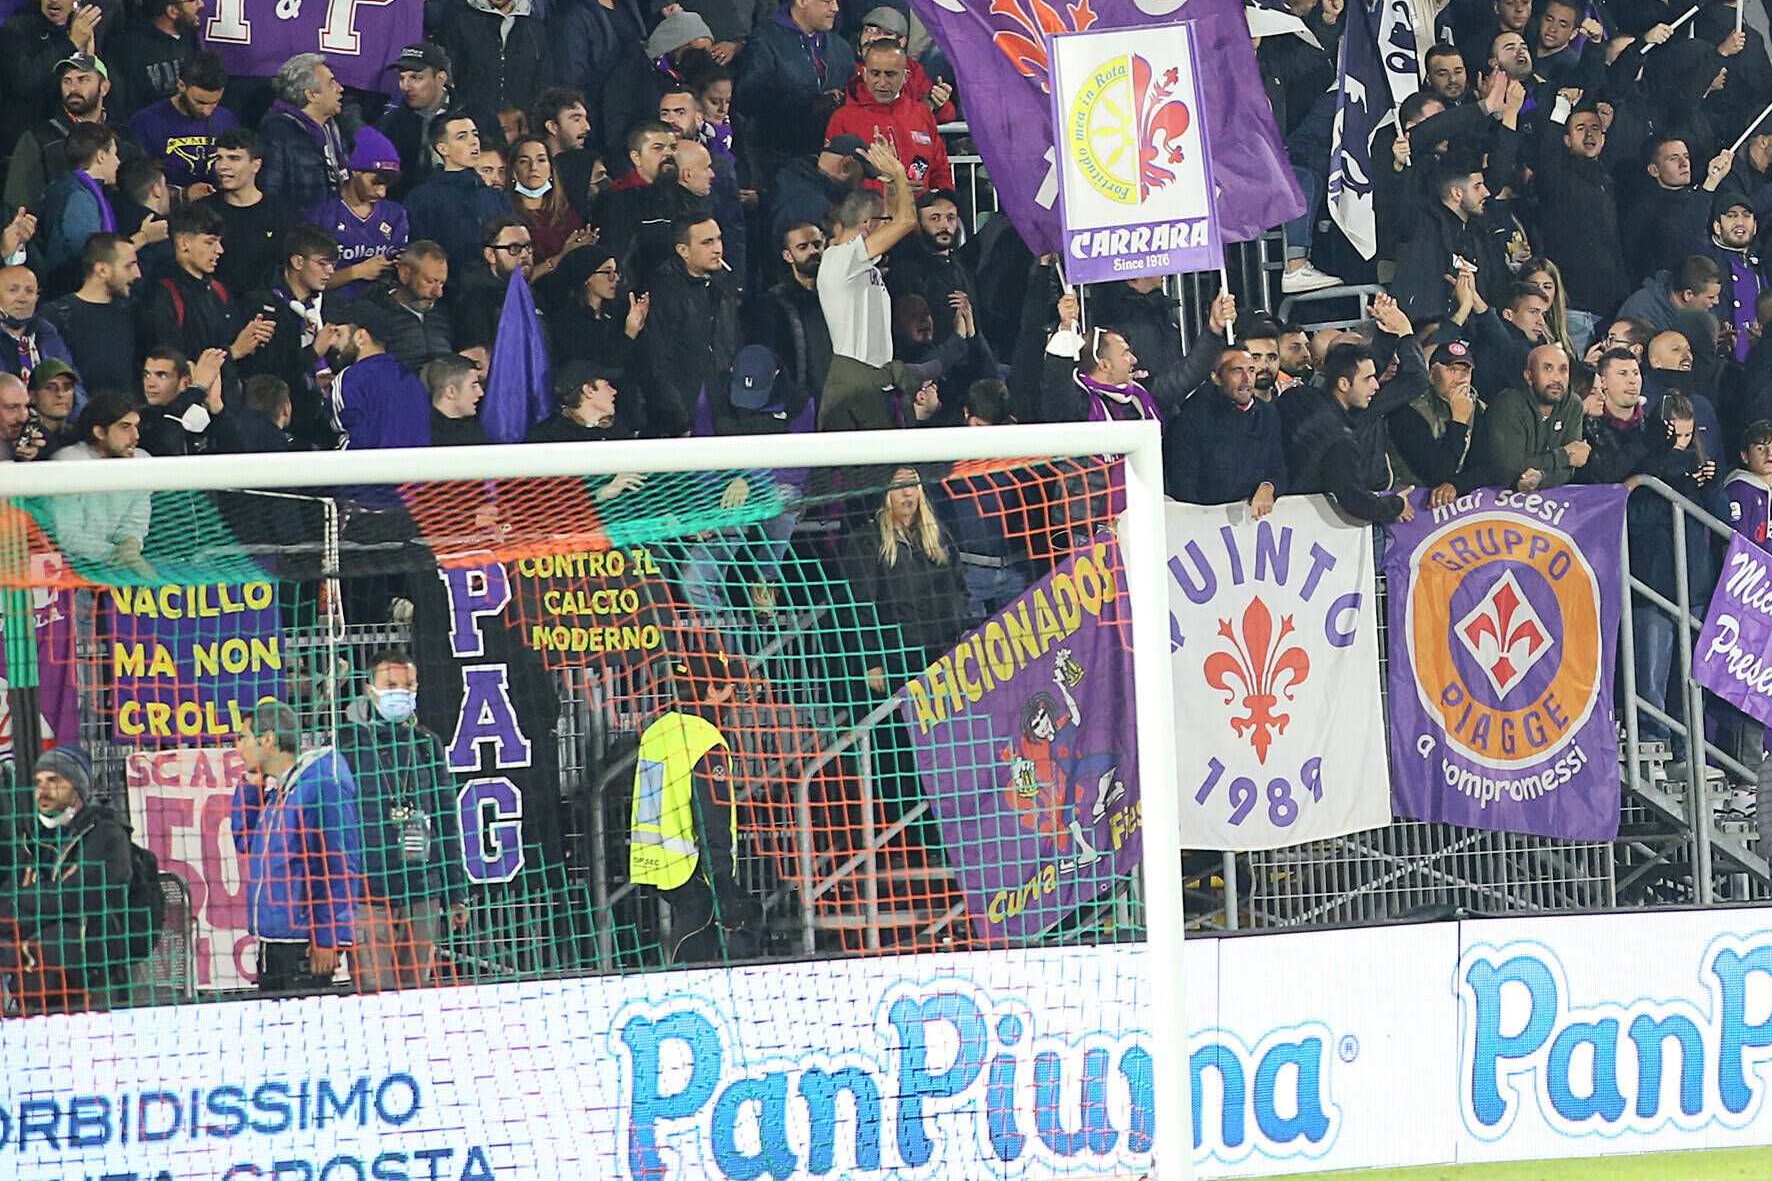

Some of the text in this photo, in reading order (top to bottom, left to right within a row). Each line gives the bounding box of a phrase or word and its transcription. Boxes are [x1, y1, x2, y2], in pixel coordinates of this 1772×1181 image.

[1070, 219, 1210, 260] CARRARA
[1113, 257, 1145, 273] Since
[1494, 489, 1570, 526] scesi
[517, 551, 625, 579] CONTRO
[1431, 527, 1573, 582] GRUPPO
[543, 587, 640, 616] CALCIO
[114, 636, 283, 677] MA NON
[532, 624, 661, 652] MODERNO
[906, 542, 1116, 736] AFICIONADOS
[118, 695, 279, 737] CROLL
[1440, 680, 1570, 756] PIAGGE
[987, 862, 1057, 924] Curva
[0, 1071, 422, 1153] RBIDISSIMO
